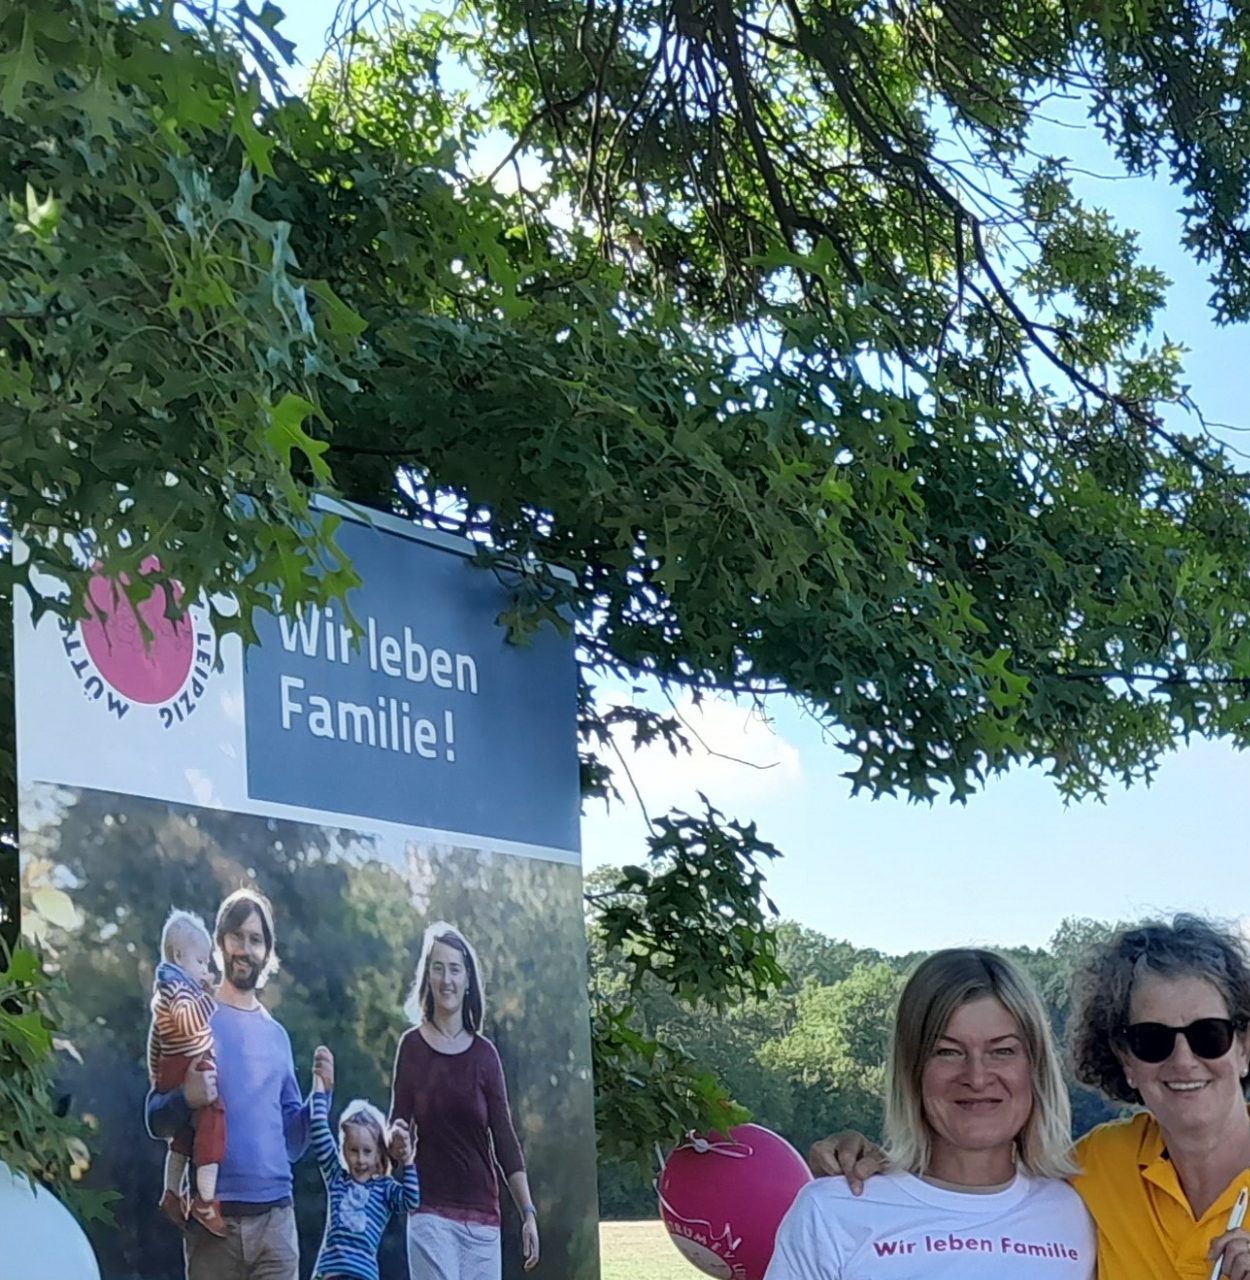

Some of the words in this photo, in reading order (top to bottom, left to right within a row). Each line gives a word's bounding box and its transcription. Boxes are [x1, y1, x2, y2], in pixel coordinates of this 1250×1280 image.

[159, 632, 211, 729] LEIPZIG
[277, 603, 358, 664] Wir
[368, 617, 478, 695] leben
[280, 675, 457, 762] Familie!
[873, 1236, 917, 1258] Wir
[926, 1233, 993, 1254] leben
[1000, 1237, 1080, 1261] Familie
